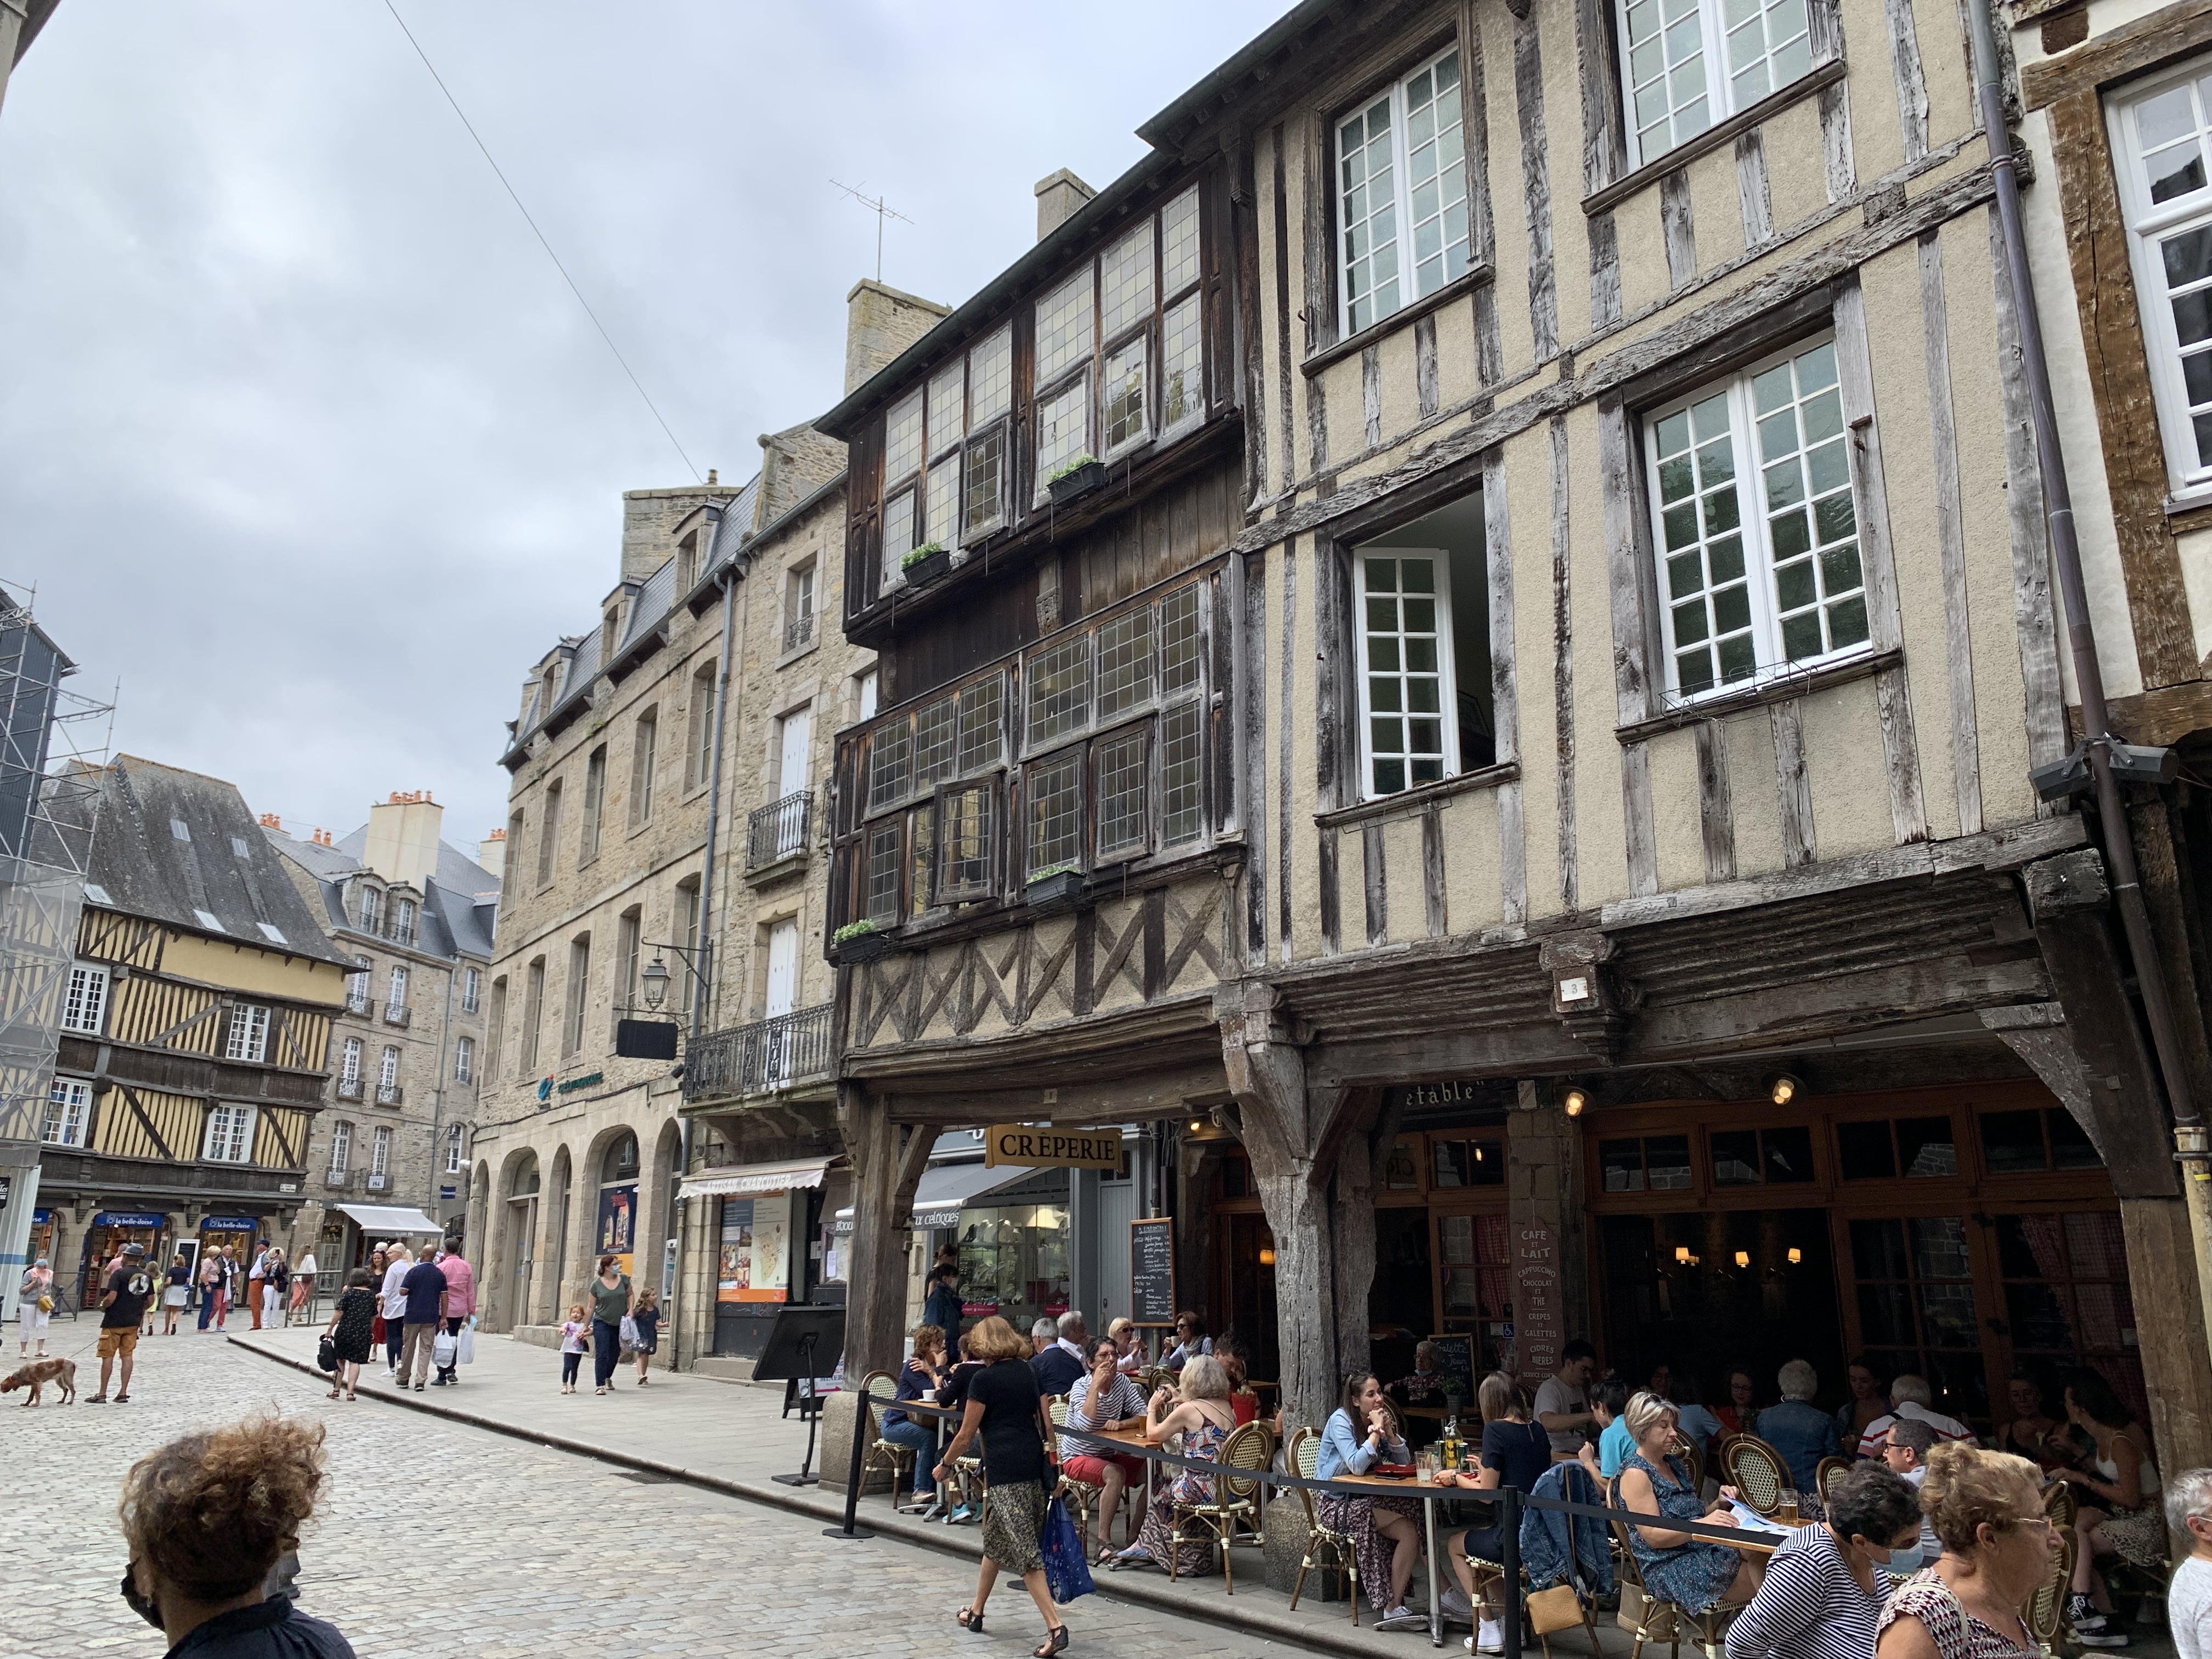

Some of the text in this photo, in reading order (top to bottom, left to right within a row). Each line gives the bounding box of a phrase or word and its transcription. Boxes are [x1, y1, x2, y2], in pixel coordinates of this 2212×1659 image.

[1571, 984, 1578, 995] 3
[1000, 1132, 1115, 1160] CRÊPERIE
[707, 1174, 792, 1191] ARTISAN CHARCUTIER
[1521, 1230, 1547, 1240] CAFE
[1521, 1247, 1551, 1259] LAIT
[1518, 1266, 1556, 1278] CAPPUCCINO
[1532, 1297, 1545, 1306] THE
[1530, 1345, 1555, 1354] CIDRES
[1532, 1356, 1554, 1365] BIERES
